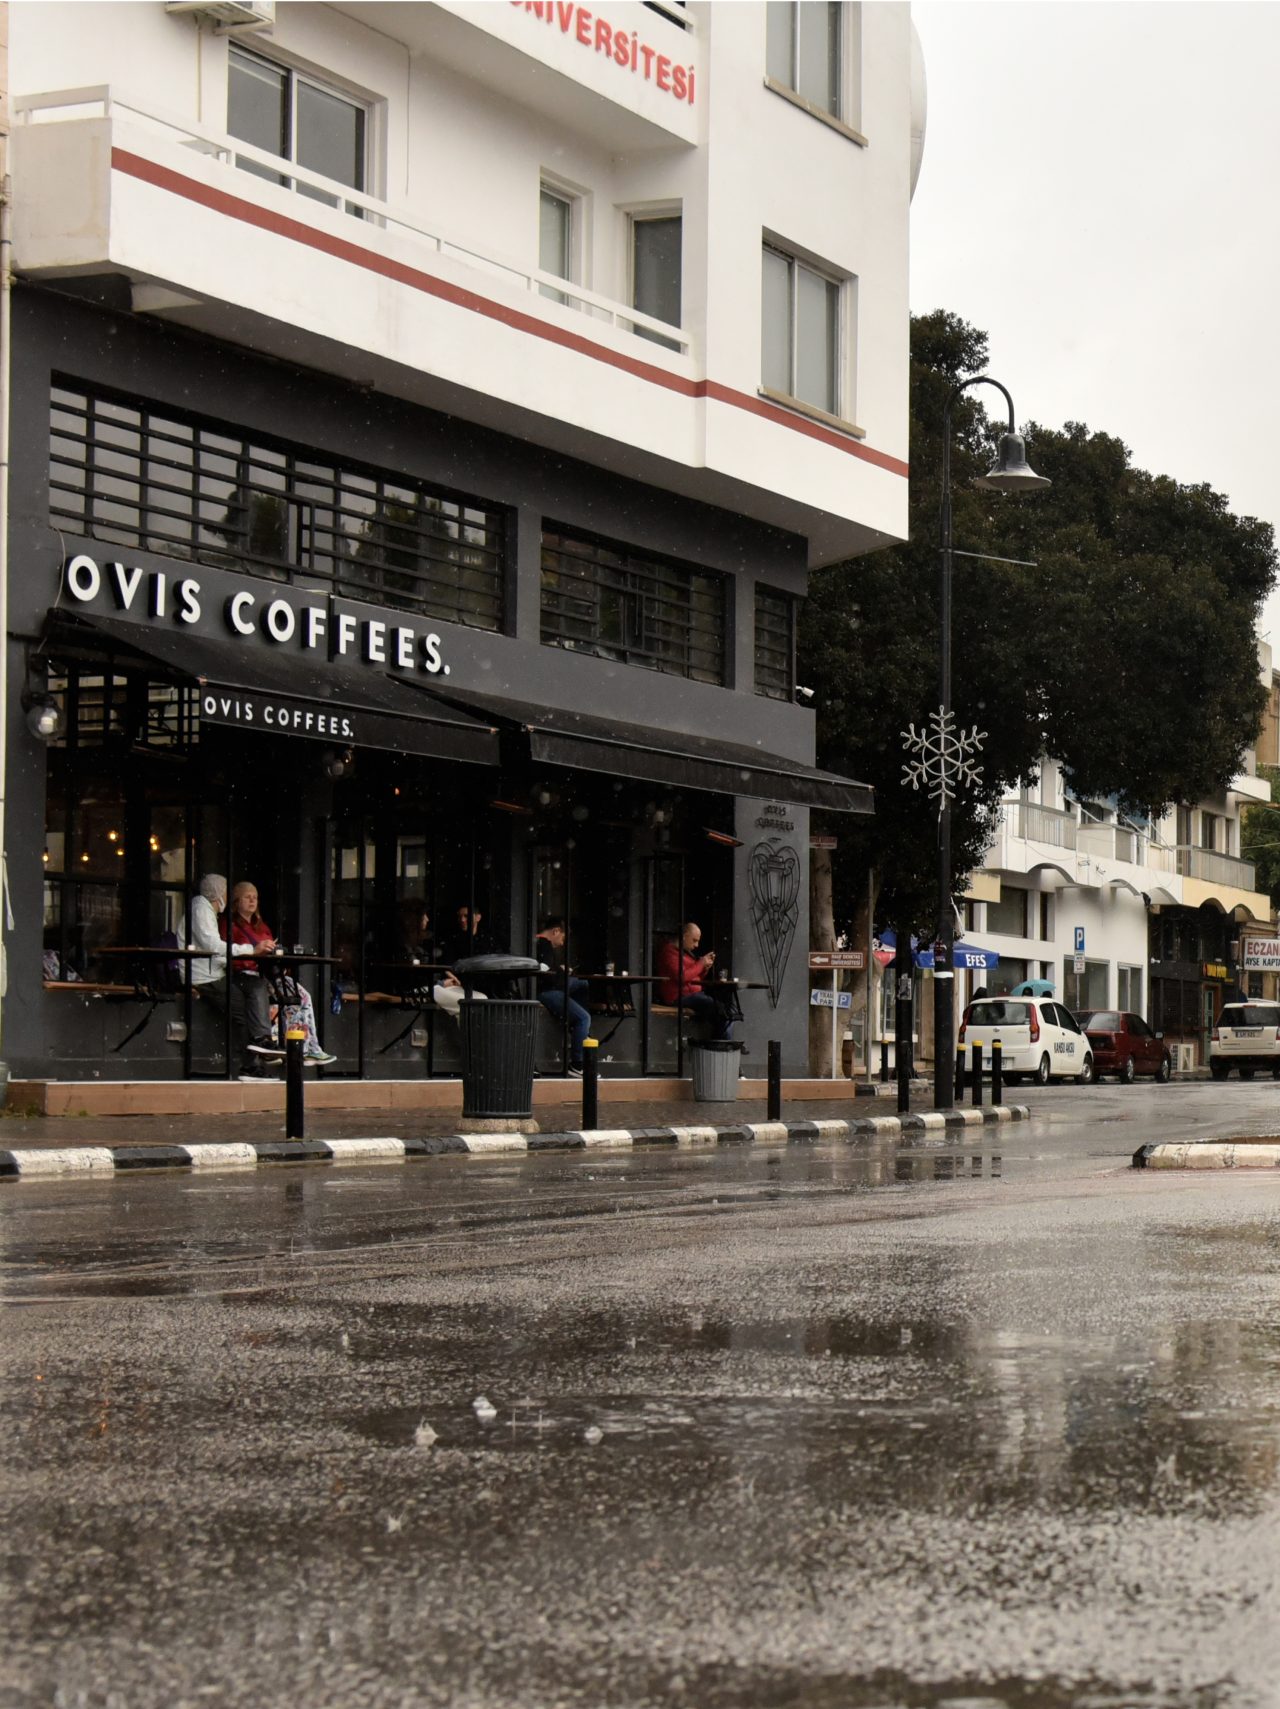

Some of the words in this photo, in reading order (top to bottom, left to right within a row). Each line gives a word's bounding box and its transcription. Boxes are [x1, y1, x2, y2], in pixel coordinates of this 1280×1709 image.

[66, 555, 201, 624] OVIS
[230, 591, 451, 676] COFFEES.
[204, 696, 253, 721] OVIS
[264, 706, 354, 737] COFFEES.
[965, 953, 986, 968] EFES
